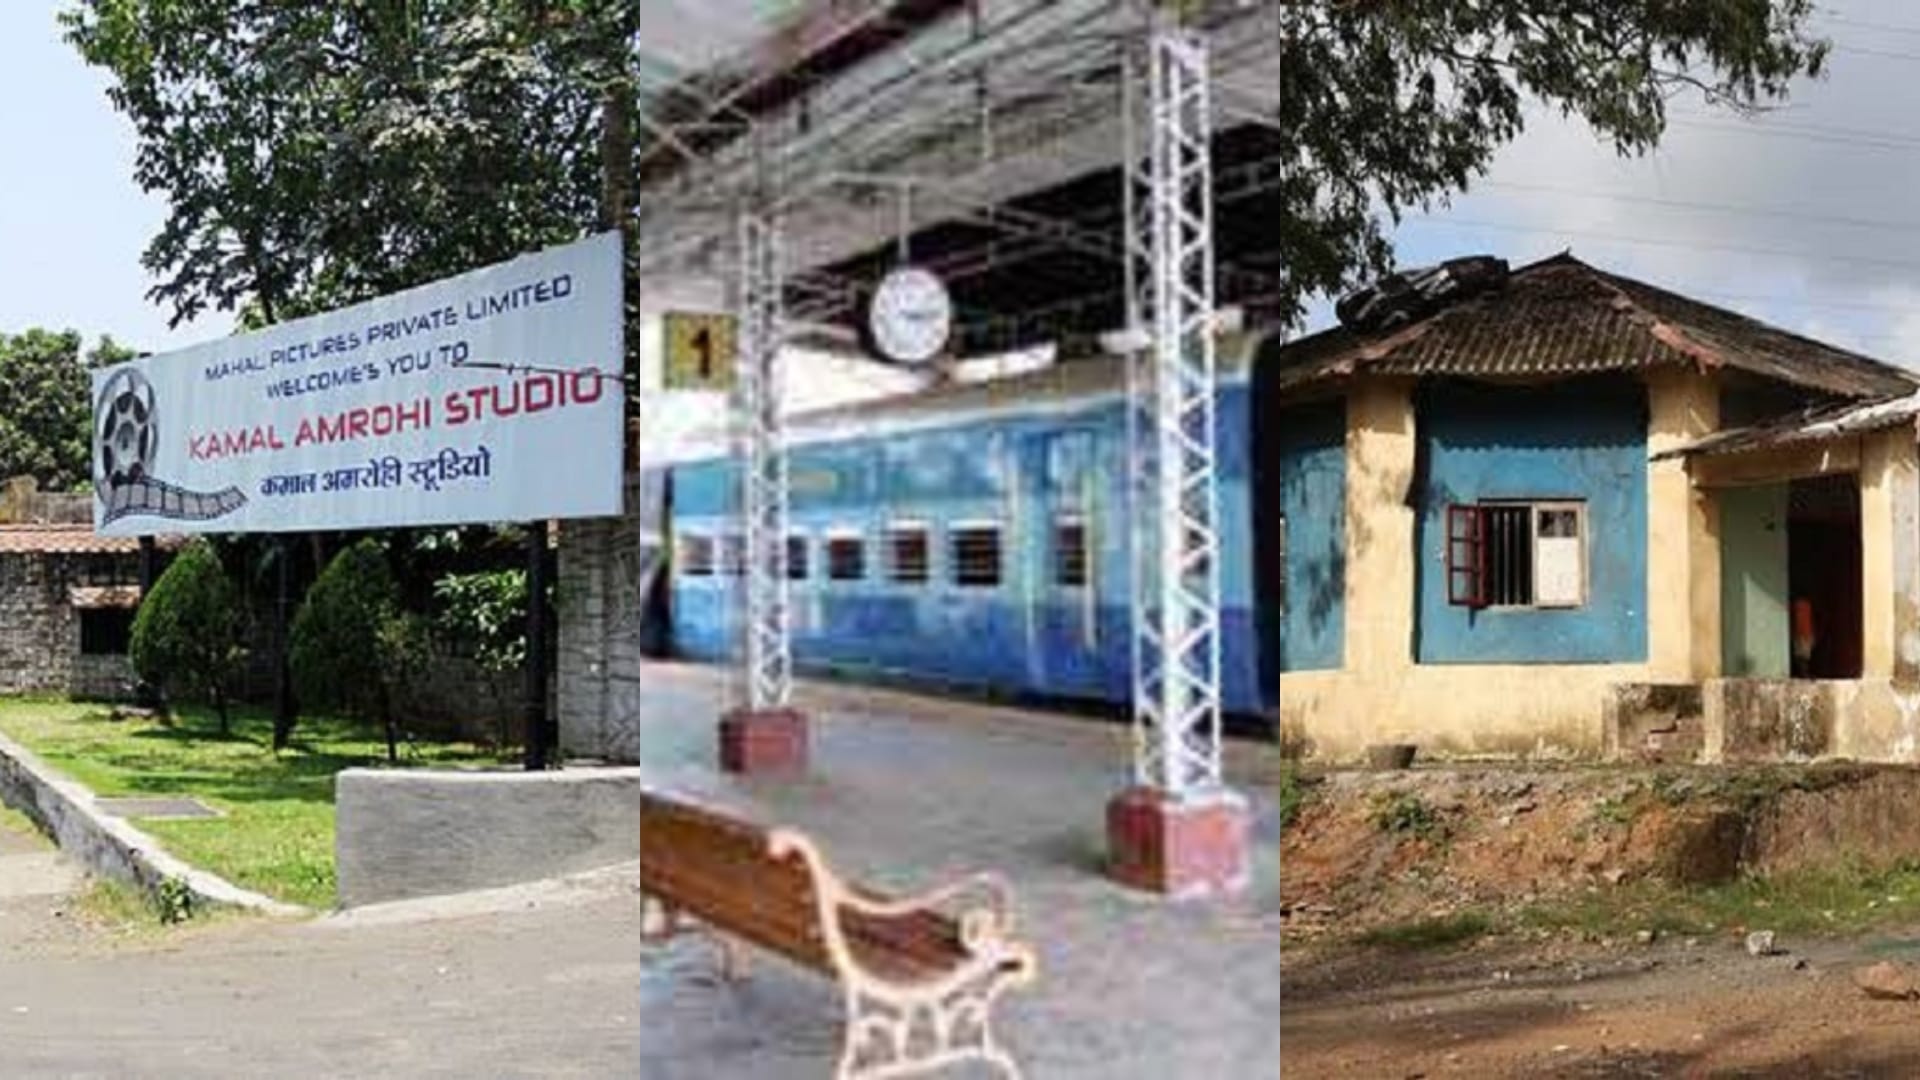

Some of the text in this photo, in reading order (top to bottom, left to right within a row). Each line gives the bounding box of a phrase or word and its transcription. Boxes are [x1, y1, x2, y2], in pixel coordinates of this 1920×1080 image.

[205, 274, 572, 380] MAHAL PICTURES PRIVATE LIMITED
[691, 329, 710, 378] 1
[267, 341, 469, 398] WELCOME'S YOU TO
[188, 367, 603, 461] KAMAL AMROHI STUDIO
[260, 472, 317, 496] कमाल
[408, 445, 491, 491] स्टूडियो
